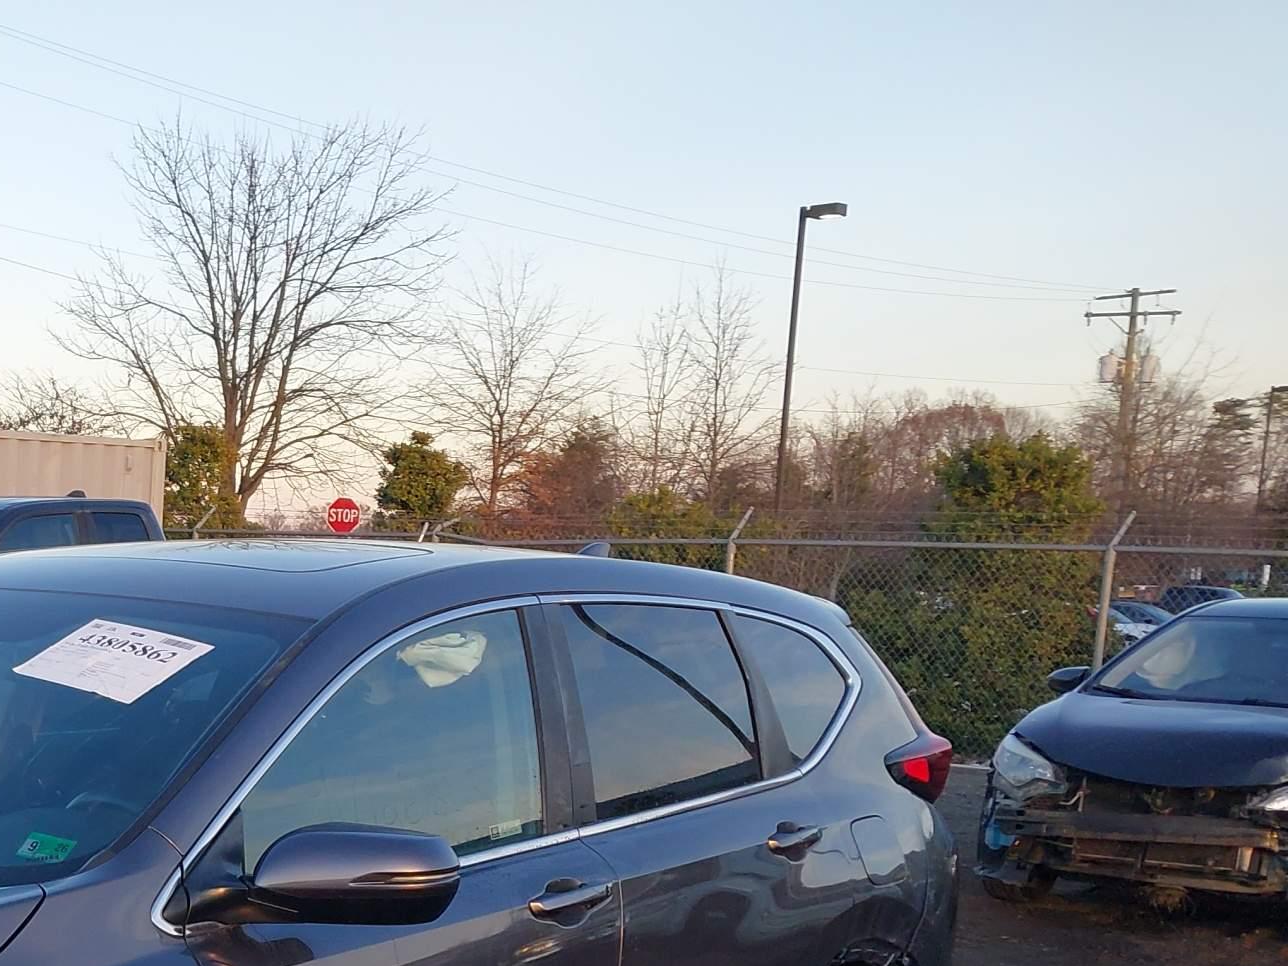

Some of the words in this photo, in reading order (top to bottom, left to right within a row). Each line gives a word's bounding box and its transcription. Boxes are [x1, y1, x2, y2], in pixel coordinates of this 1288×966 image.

[329, 508, 359, 523] STOP
[79, 634, 178, 663] 43805862
[27, 840, 40, 852] 9
